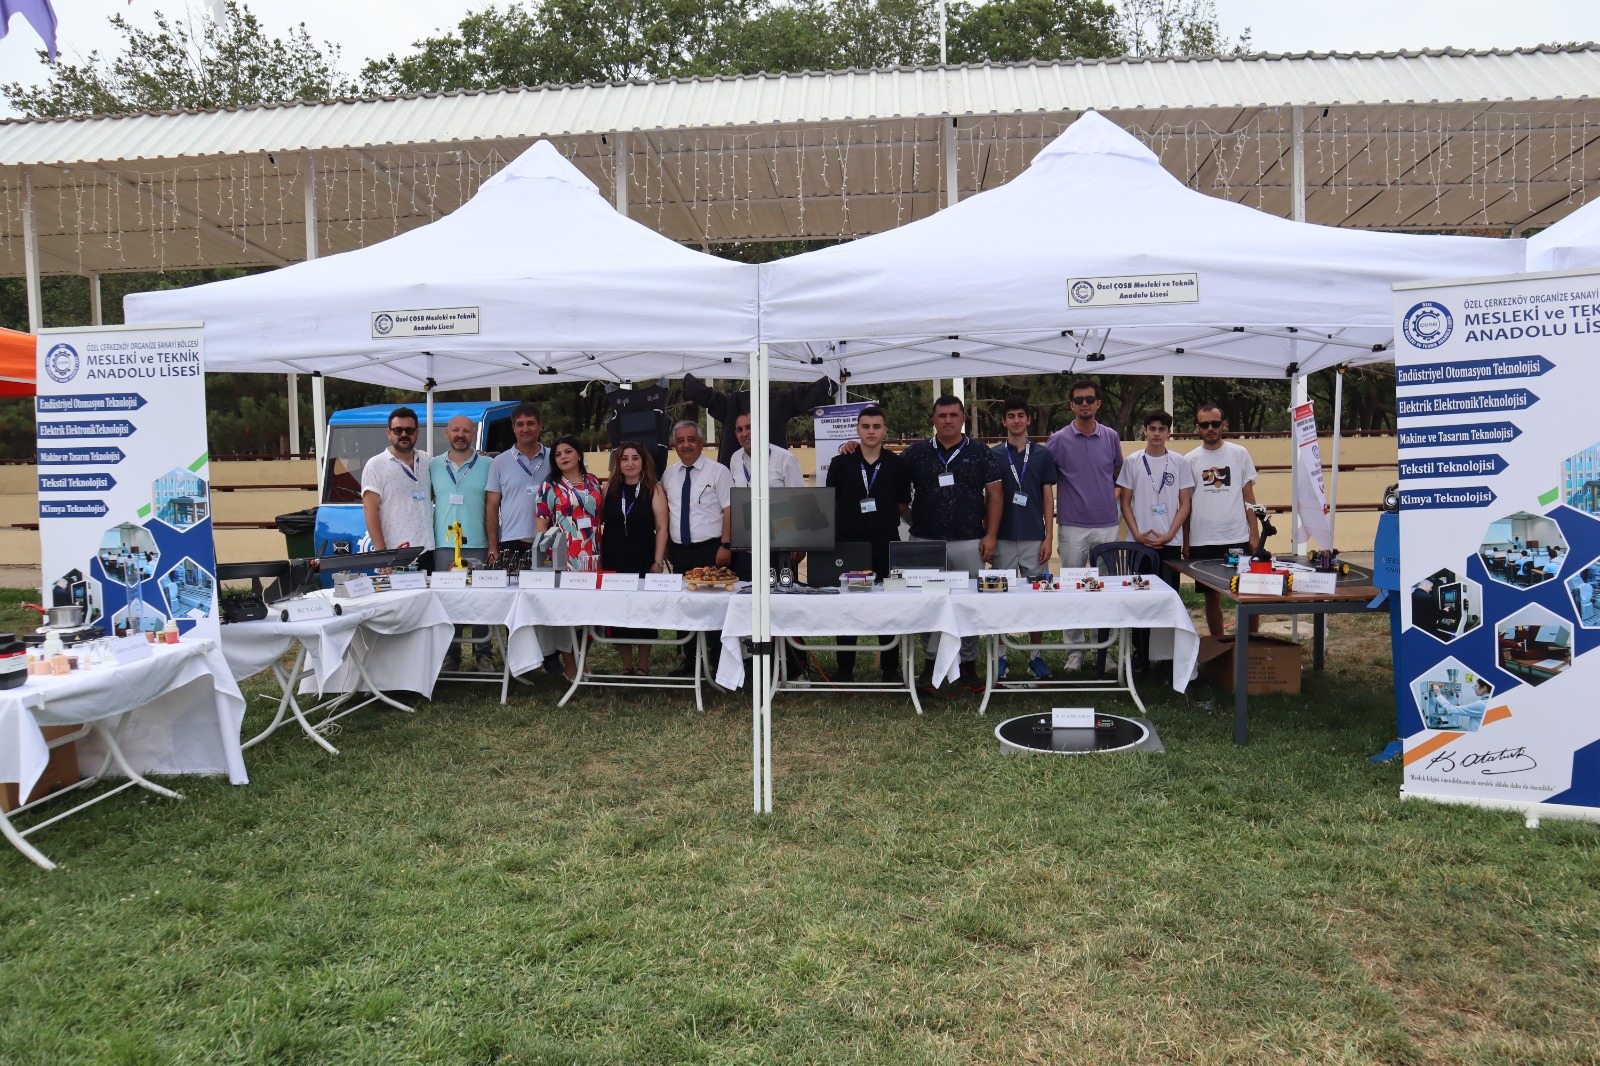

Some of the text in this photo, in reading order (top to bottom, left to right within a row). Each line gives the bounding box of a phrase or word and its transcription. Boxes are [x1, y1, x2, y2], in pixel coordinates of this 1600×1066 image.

[1464, 288, 1599, 310] ÖZEL ÇERKEZKÖY ORGANİZE SANAYİ
[1465, 305, 1539, 326] MESLEKİ
[1545, 309, 1564, 319] ve
[1465, 323, 1566, 342] ANADOLU
[87, 339, 198, 352] ÖZEL ÇERKEZKÖY ORGANİZE SANAYİ BÖLGESİ
[87, 349, 200, 365] MESLEKİ ve TEKNİK
[87, 363, 200, 379] ANADOLU LİSESİ
[1398, 360, 1540, 383] Endüstriyel Otomasyon Teknolojisi
[40, 397, 137, 411] Endüstriyel Otomasyon Teknolojisi
[1399, 399, 1432, 414] Elektrik
[40, 425, 65, 435] Elektrik
[1400, 433, 1426, 444] Makine
[1438, 432, 1469, 442] Tasarım
[1471, 427, 1514, 441] Teknolojisi
[41, 453, 62, 461] Makine
[90, 452, 120, 462] Teknolojisi
[1401, 460, 1495, 474] Tekstil Teknolojisi
[41, 478, 108, 489] Tekstil Teknolojisi
[1401, 492, 1492, 505] Kimya Teknolojisi
[41, 504, 106, 514] Kimya Teknolojisi
